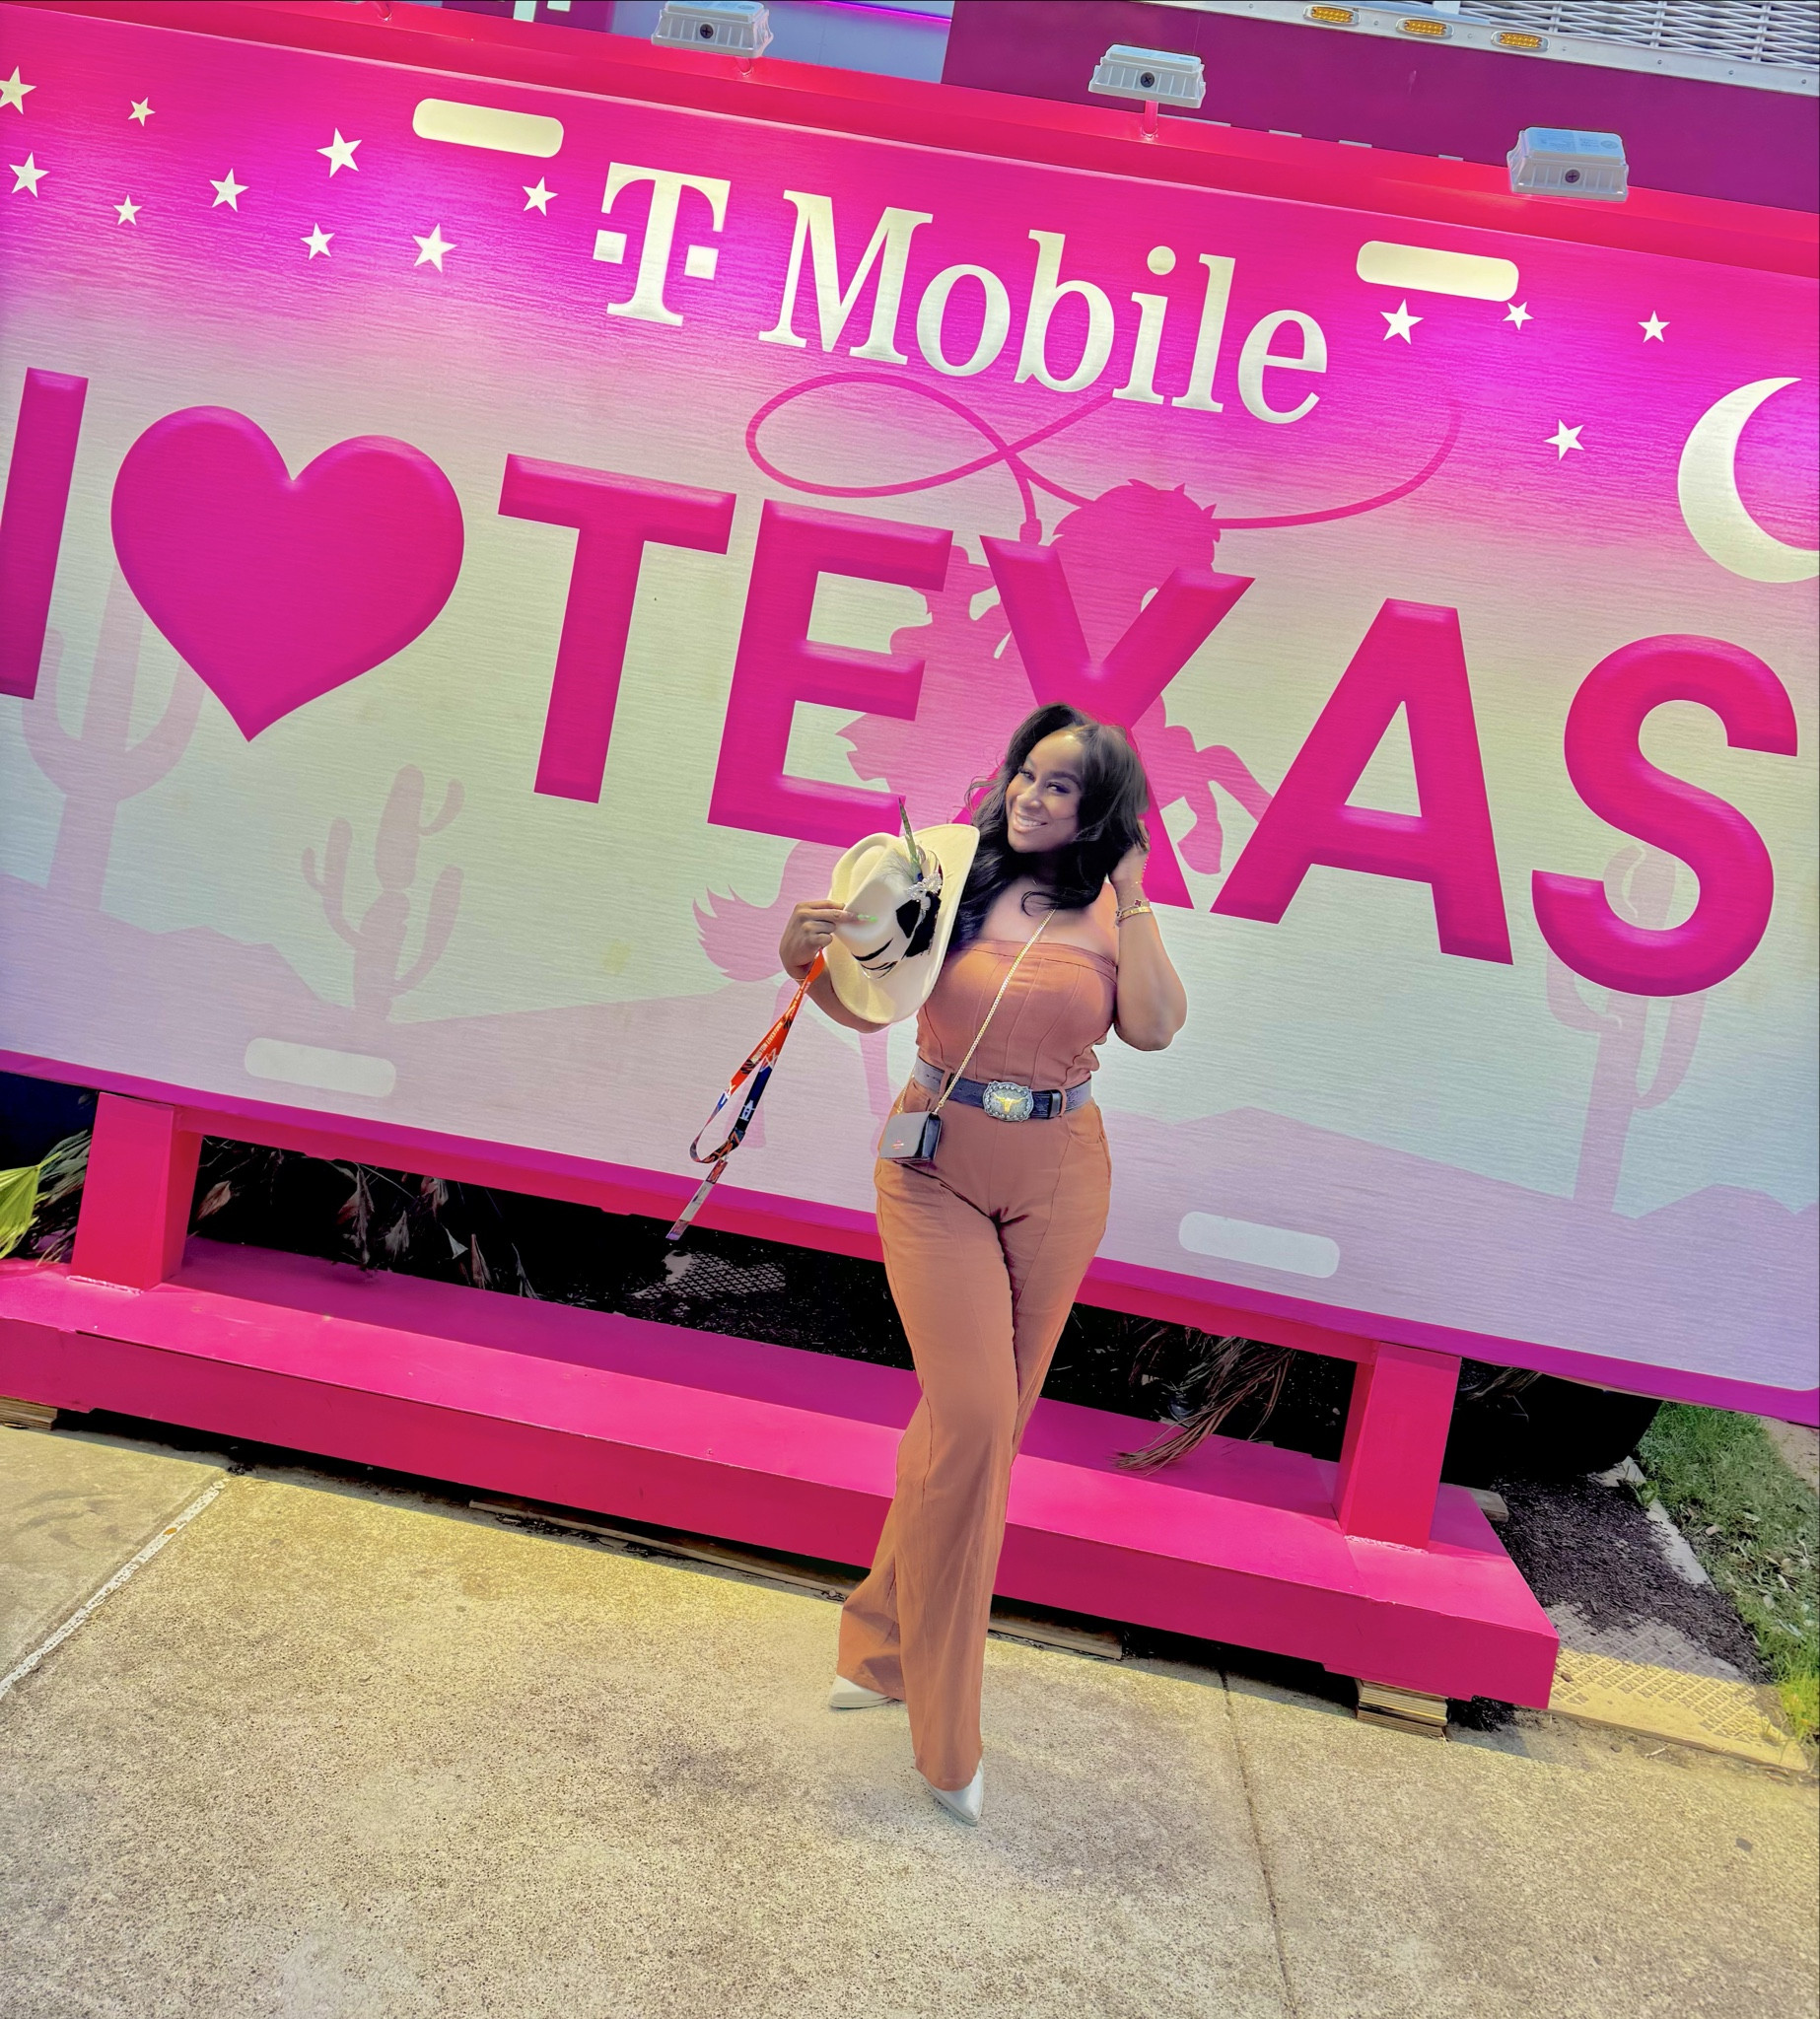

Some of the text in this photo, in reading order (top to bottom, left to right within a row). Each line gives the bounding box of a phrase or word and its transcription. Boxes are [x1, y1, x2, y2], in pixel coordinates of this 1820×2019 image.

[758, 190, 1328, 425] Mobile
[0, 369, 1797, 996] I TEXAS
